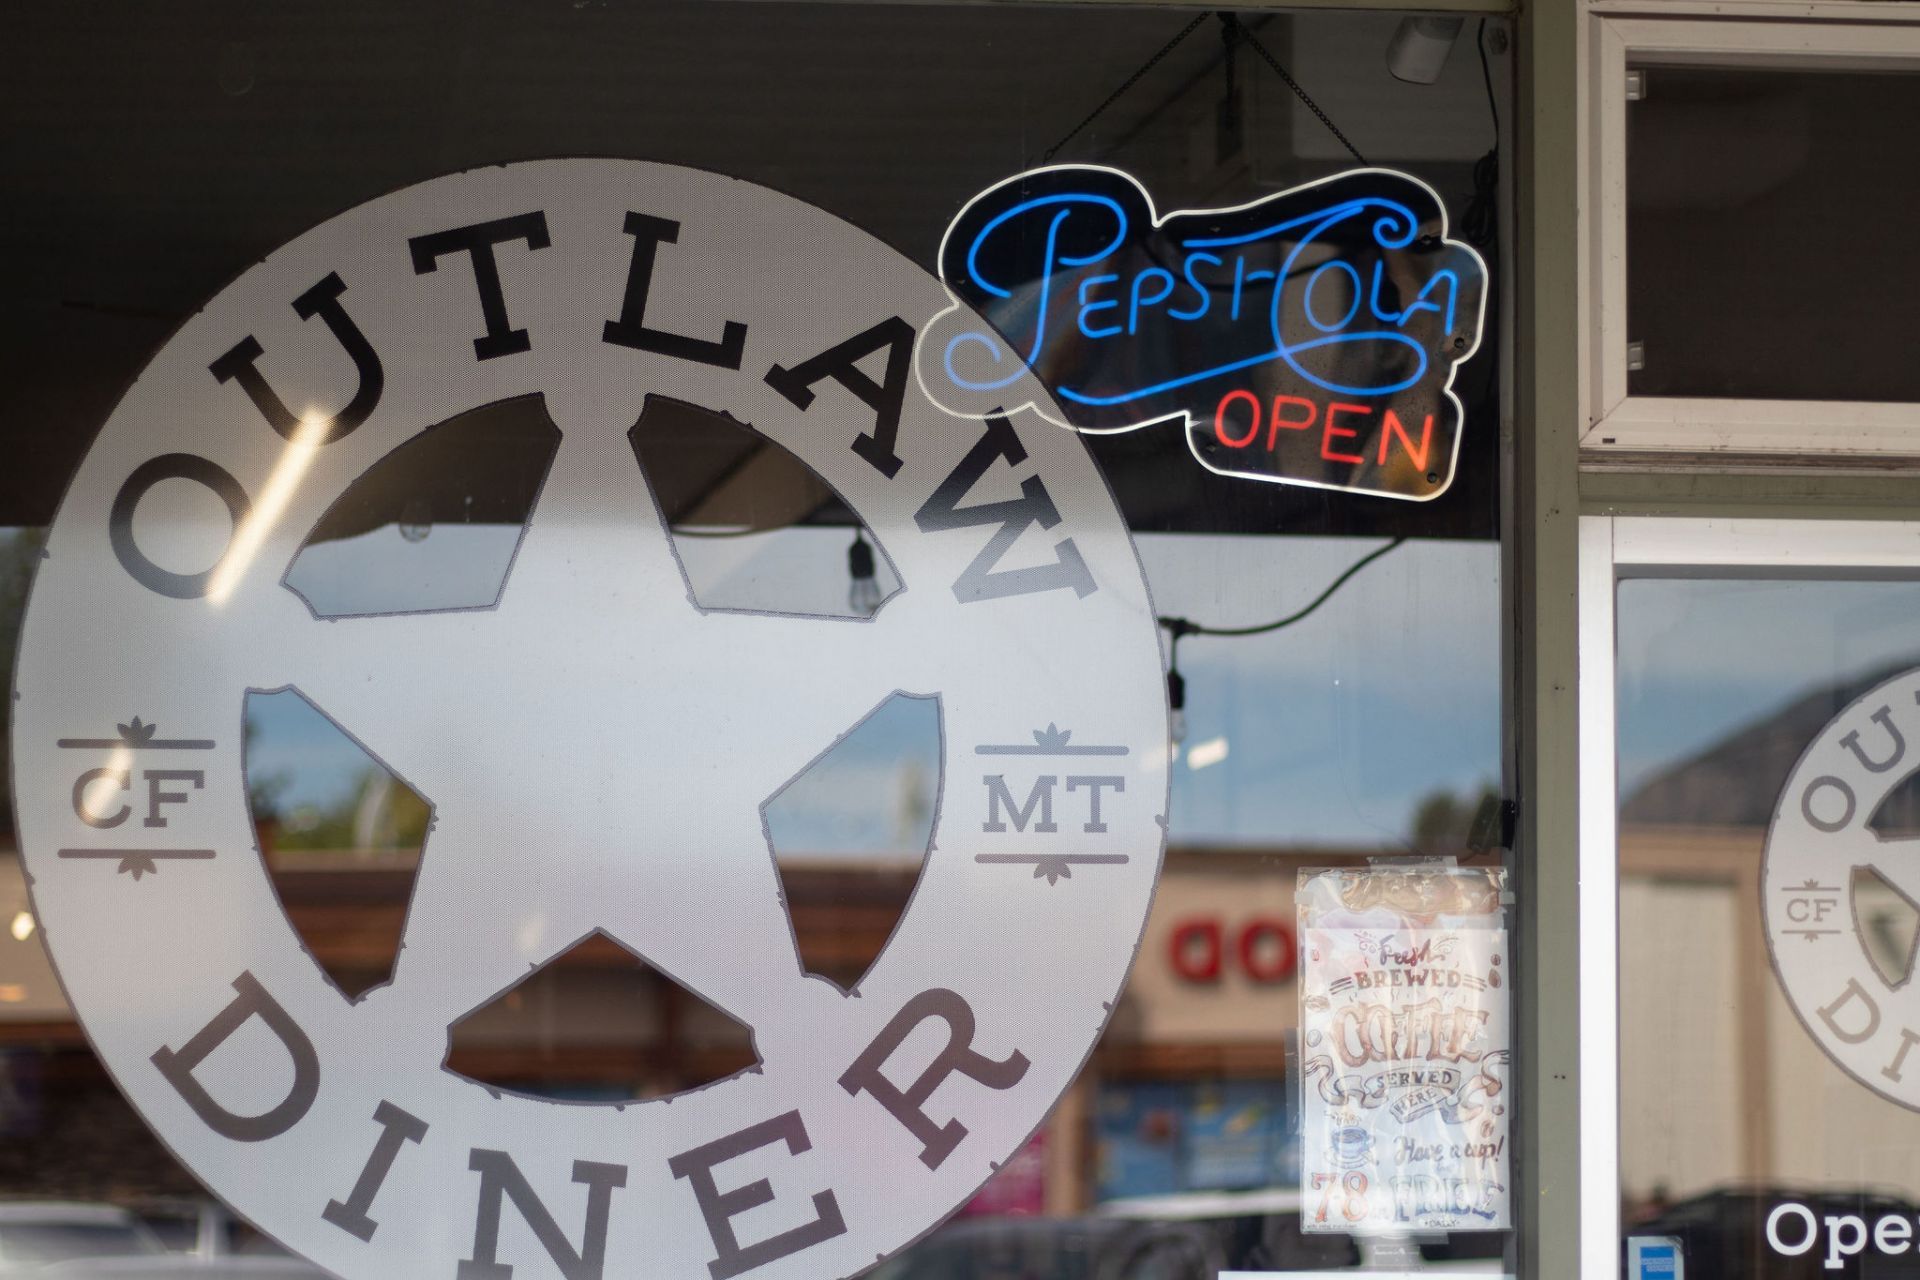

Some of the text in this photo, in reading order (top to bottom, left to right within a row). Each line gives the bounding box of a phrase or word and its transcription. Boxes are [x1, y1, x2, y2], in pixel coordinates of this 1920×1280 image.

[109, 210, 1100, 604] OUTLAW
[1212, 389, 1435, 473] OPEN
[1800, 689, 1920, 834] OU
[71, 766, 206, 830] CF
[981, 774, 1126, 834] MT
[1785, 898, 1838, 923] CF
[1354, 968, 1462, 989] BREWED
[1330, 997, 1490, 1068] COFFEE
[1376, 1071, 1453, 1089] SERVED
[150, 969, 1032, 1280] DINER
[1393, 1136, 1444, 1166] Have
[1766, 1202, 1920, 1269] Ope
